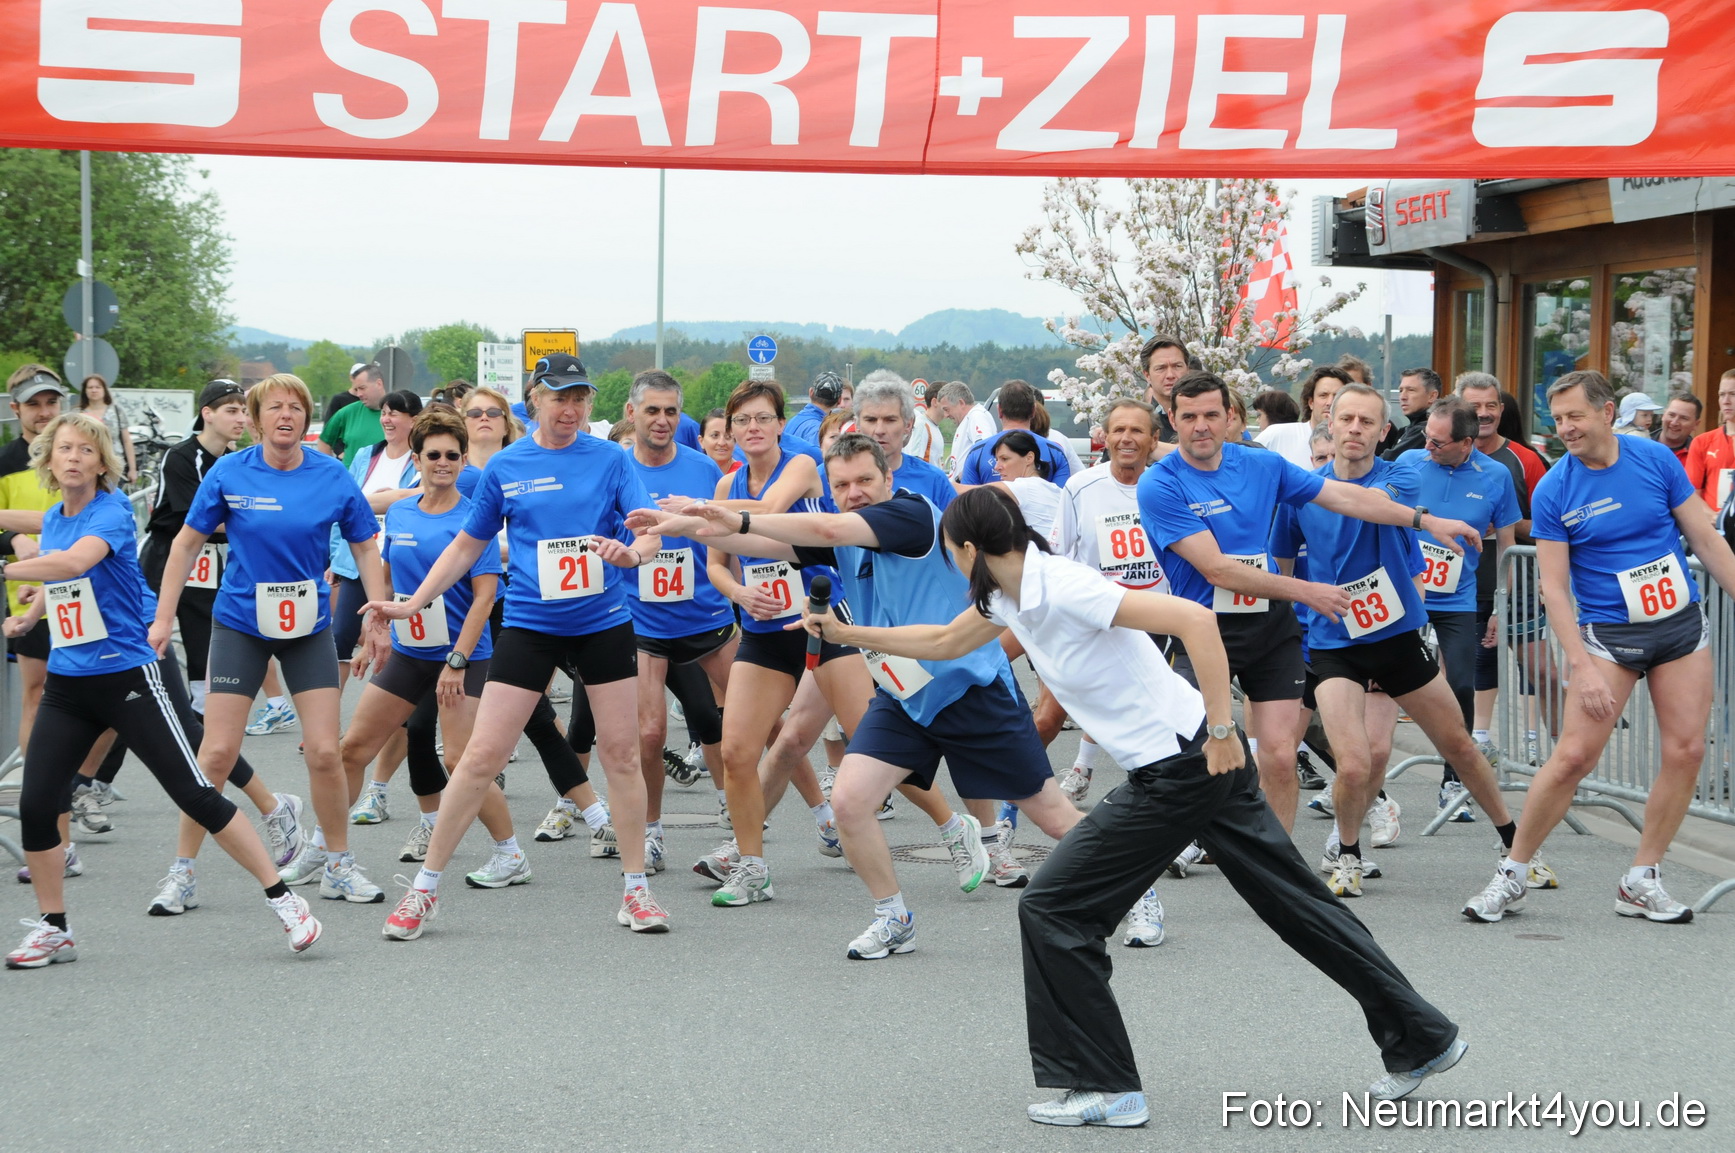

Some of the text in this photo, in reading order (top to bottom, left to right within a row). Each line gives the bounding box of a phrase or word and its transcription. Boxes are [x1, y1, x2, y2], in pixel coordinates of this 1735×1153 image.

[1395, 189, 1451, 226] SEAT
[529, 346, 572, 356] Neumarkt
[915, 385, 925, 395] 60
[1104, 514, 1131, 523] MEYER
[547, 540, 577, 549] MEYER
[1110, 527, 1145, 559] 86
[1422, 544, 1445, 555] MEYER
[547, 547, 578, 555] WERBUNG
[559, 555, 590, 591] 21
[752, 565, 775, 575] MEYER
[1420, 557, 1449, 587] 93
[1629, 564, 1659, 579] MEYER
[1630, 570, 1661, 584] WERBUNG
[267, 585, 296, 593] MEYER
[653, 566, 685, 598] 64
[48, 585, 68, 595] MEYER
[267, 591, 297, 599] WERBUNG
[1639, 577, 1677, 616] 66
[279, 599, 295, 632] 9
[1350, 592, 1389, 629] 63
[56, 601, 84, 640] 67
[408, 612, 425, 640] 8
[212, 676, 240, 685] ODLO
[881, 661, 905, 692] 1
